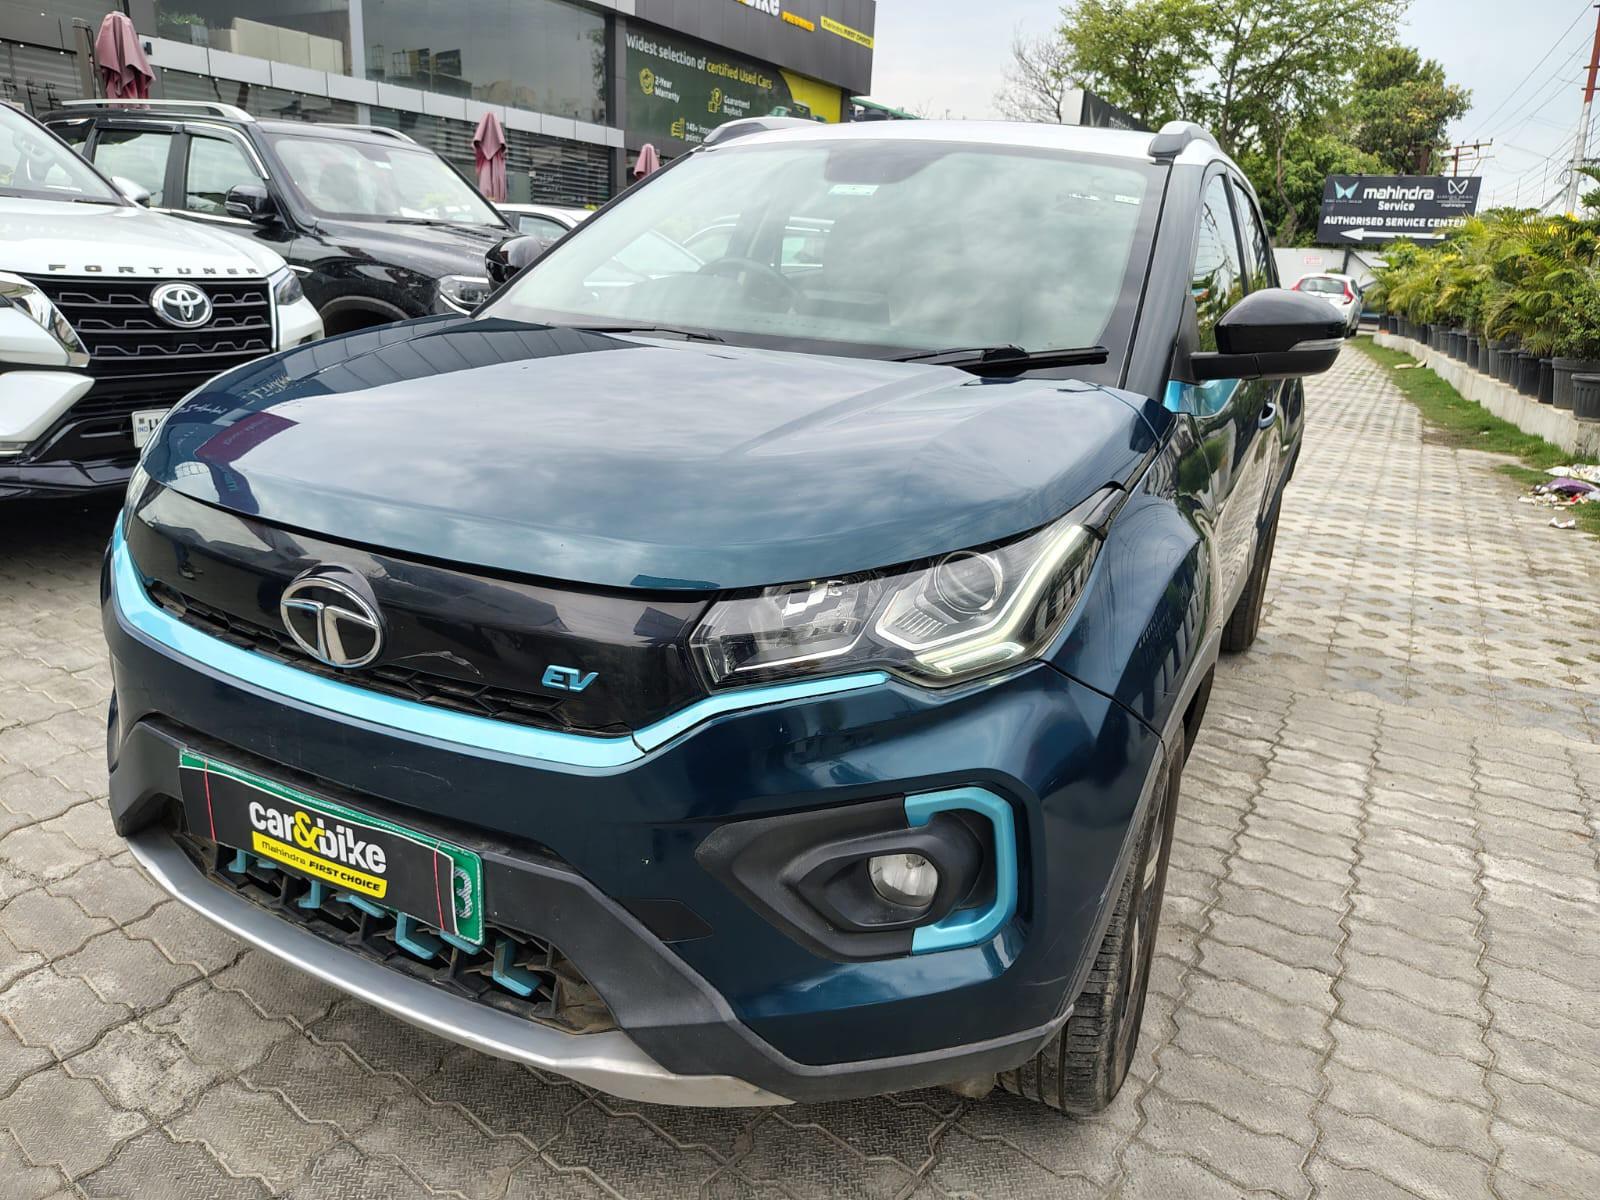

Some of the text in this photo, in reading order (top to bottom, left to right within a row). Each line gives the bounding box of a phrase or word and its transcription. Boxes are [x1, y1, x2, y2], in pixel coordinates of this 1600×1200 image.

[625, 33, 657, 56] Widest
[658, 45, 697, 68] selection
[697, 56, 707, 71] of
[740, 68, 758, 86] Used
[758, 74, 773, 90] Cars
[654, 86, 680, 104] Warranty
[1363, 185, 1435, 200] mahindra
[1377, 200, 1416, 212] Service
[1323, 215, 1384, 226] AUTHORISED
[1384, 217, 1426, 228] SERVICE
[48, 263, 260, 275] FORTUNER
[541, 664, 599, 692] EV
[249, 801, 387, 874] car&bike
[261, 840, 381, 892] Mahindra FIRST CHOICE
